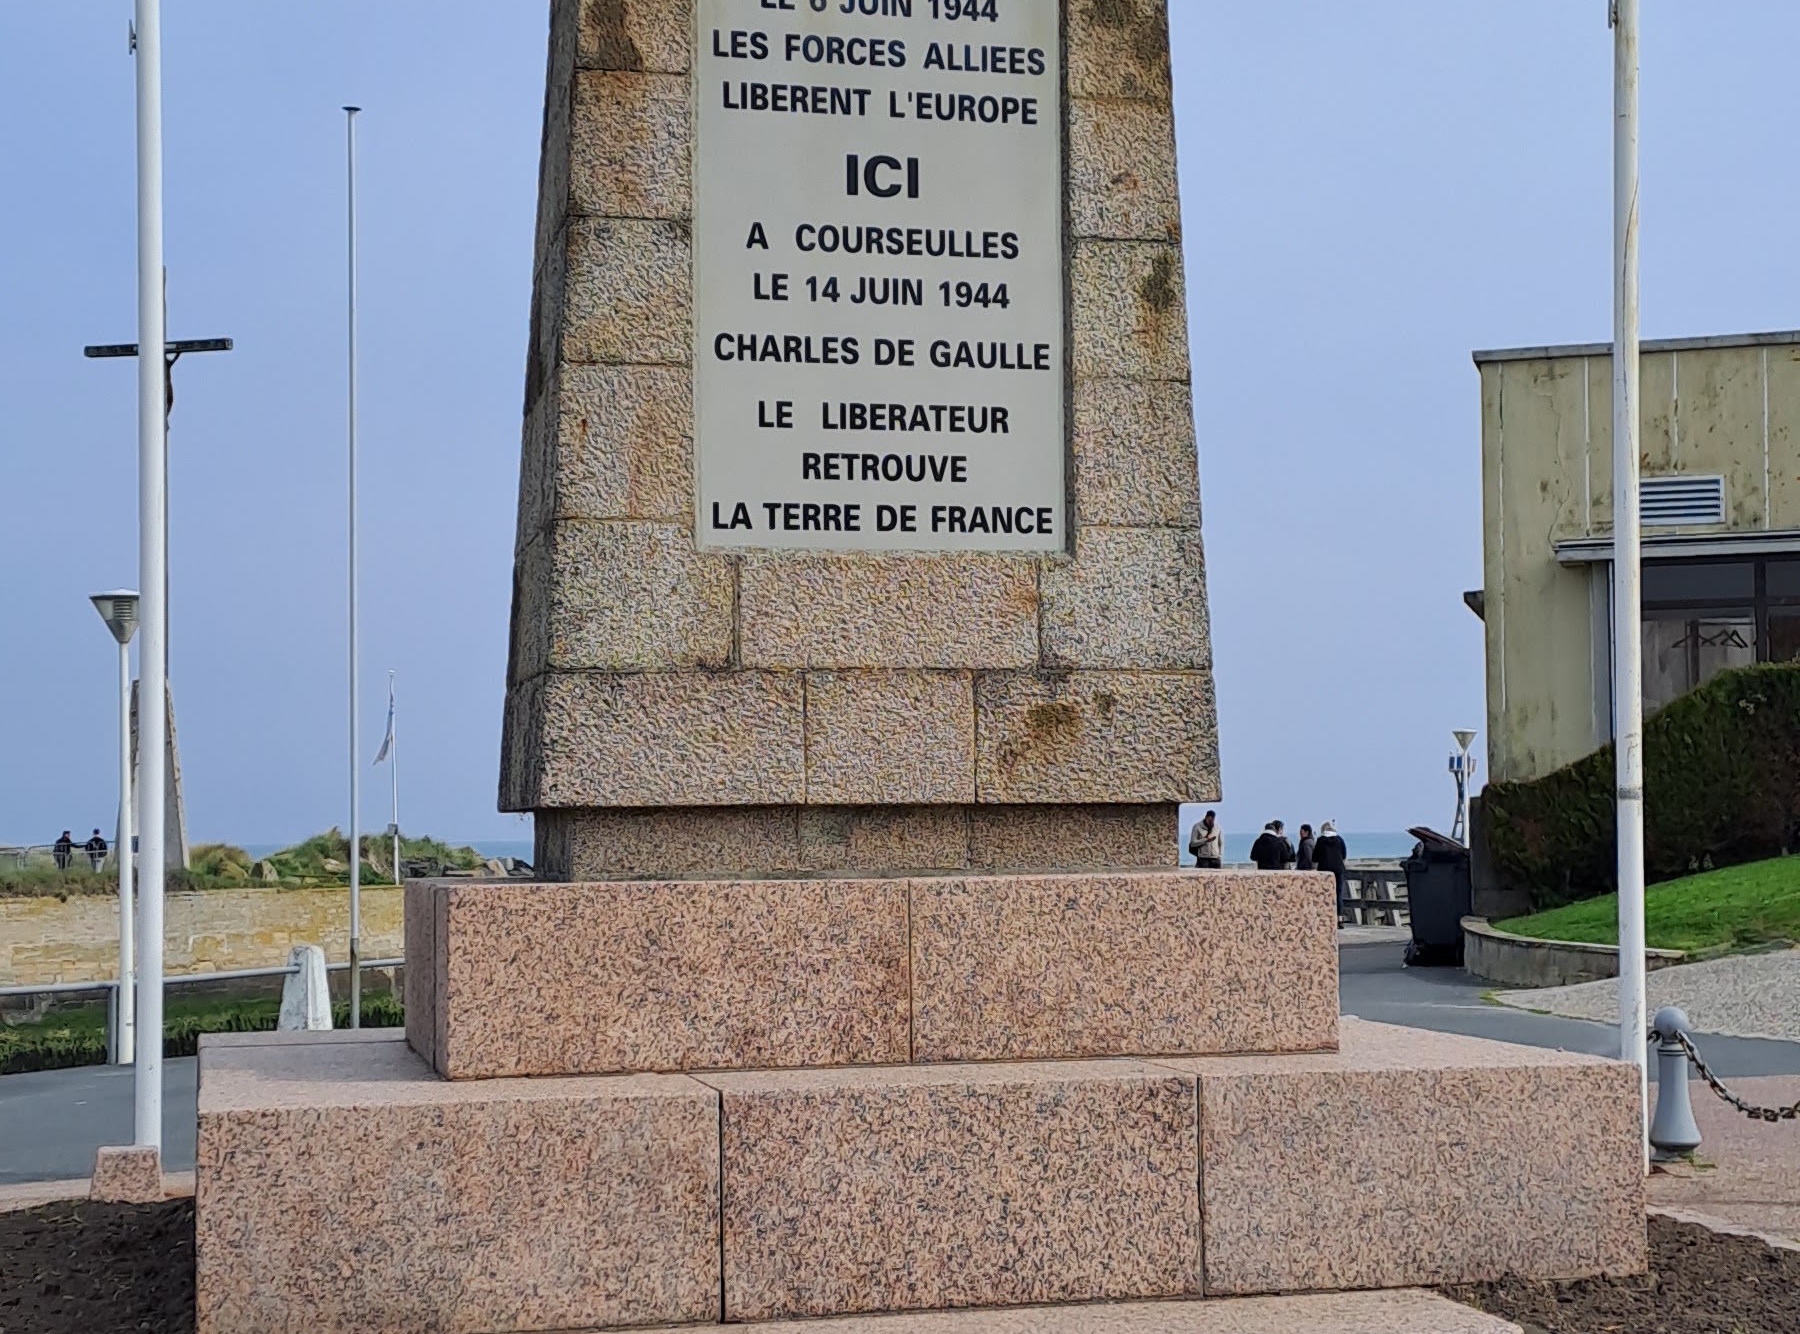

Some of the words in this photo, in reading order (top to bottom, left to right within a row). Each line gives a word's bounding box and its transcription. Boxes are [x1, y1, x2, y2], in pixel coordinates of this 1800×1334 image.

[713, 29, 769, 60] LES
[785, 33, 907, 68] FORCES
[923, 42, 1046, 76] ALLIEES
[723, 81, 872, 117] LIBERENT
[890, 91, 1038, 126] L'EUROPE
[846, 153, 920, 199] ICI
[746, 221, 770, 250] A
[795, 223, 1020, 260] COURSEULLES
[754, 273, 789, 302] LE
[805, 275, 841, 304] 14
[849, 276, 923, 307] JUIN
[939, 280, 1011, 309] 1944
[713, 332, 860, 365] CHARLES
[875, 338, 915, 367] DE
[929, 340, 1051, 371] GAULLE
[759, 400, 794, 429] LE
[822, 402, 1010, 434] LIBERATEUR
[802, 452, 968, 483] RETROUVE
[713, 501, 753, 530] LA
[763, 502, 861, 532] TERRE
[877, 504, 917, 533] DE
[931, 505, 1053, 535] FRANCE
